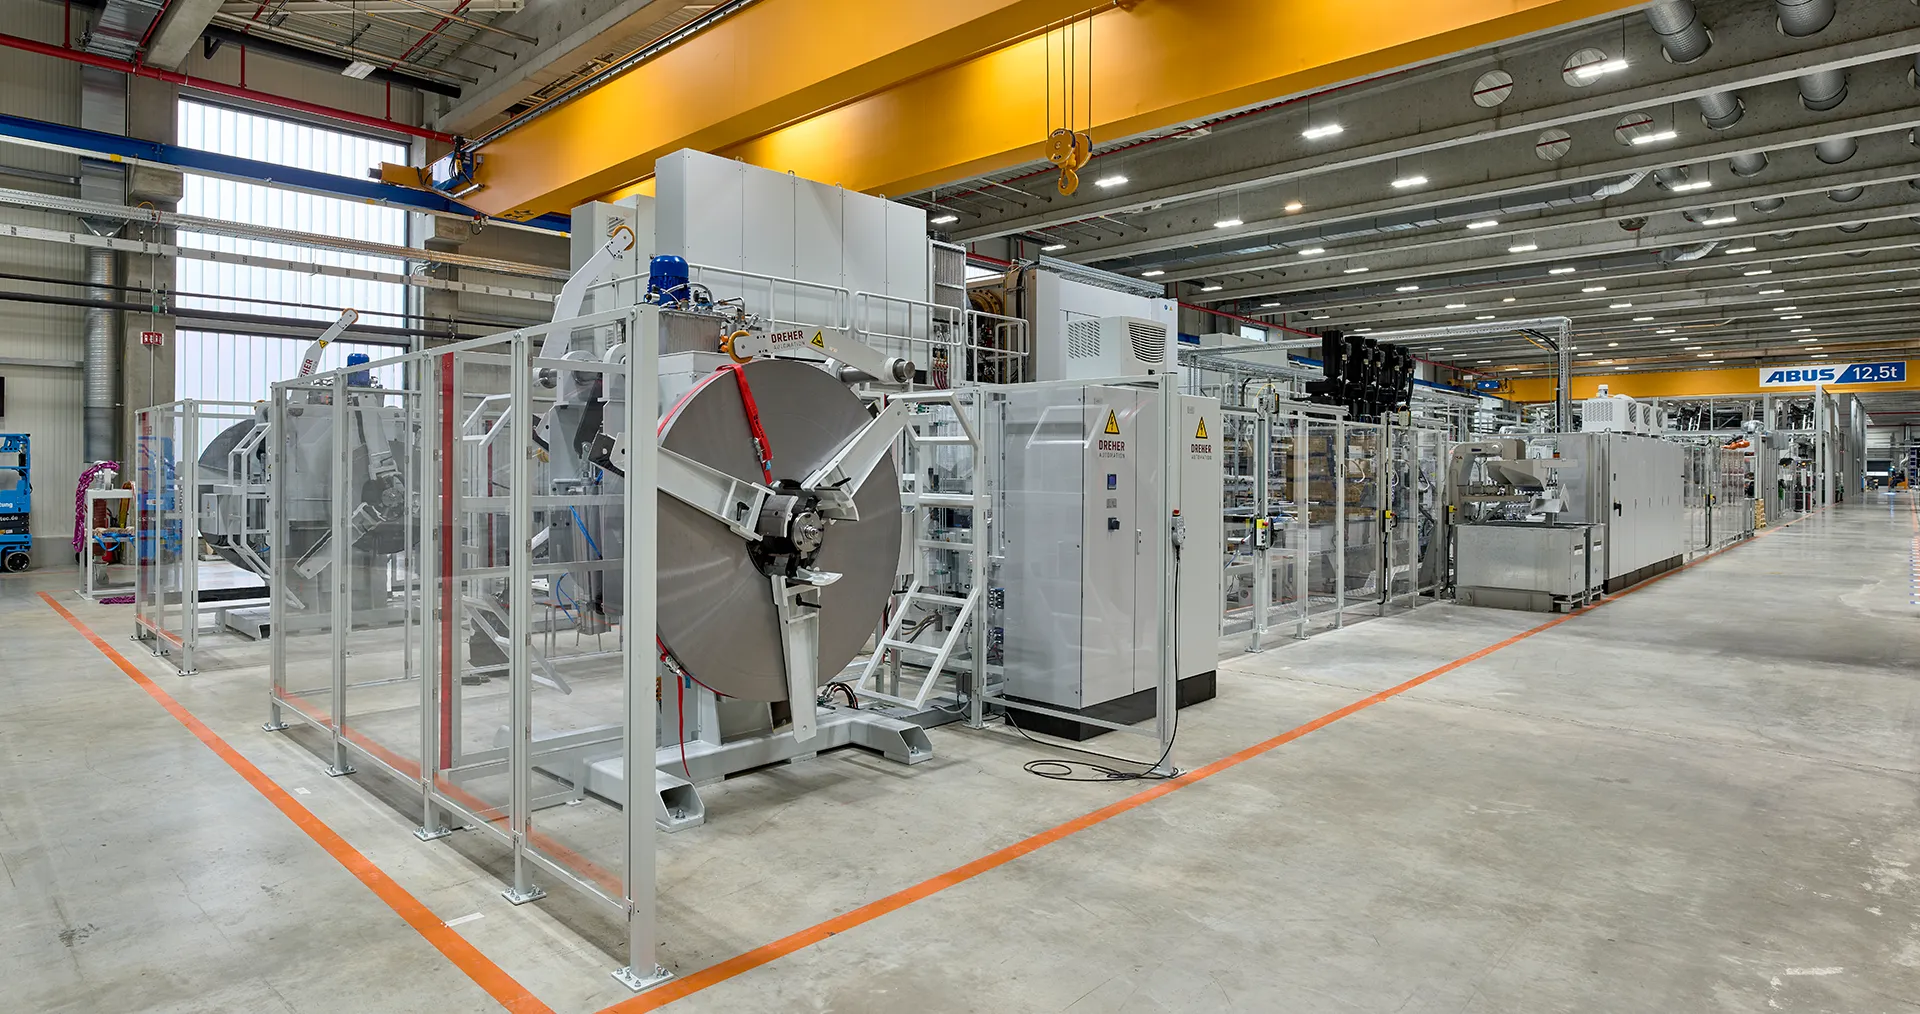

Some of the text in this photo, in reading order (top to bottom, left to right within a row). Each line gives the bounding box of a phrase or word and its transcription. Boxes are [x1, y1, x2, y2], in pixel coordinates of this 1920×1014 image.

[771, 330, 804, 343] DREHER
[1765, 366, 1898, 383] ABUS 12,5t
[1098, 440, 1125, 451] DREHER
[1191, 444, 1212, 453] DREHER
